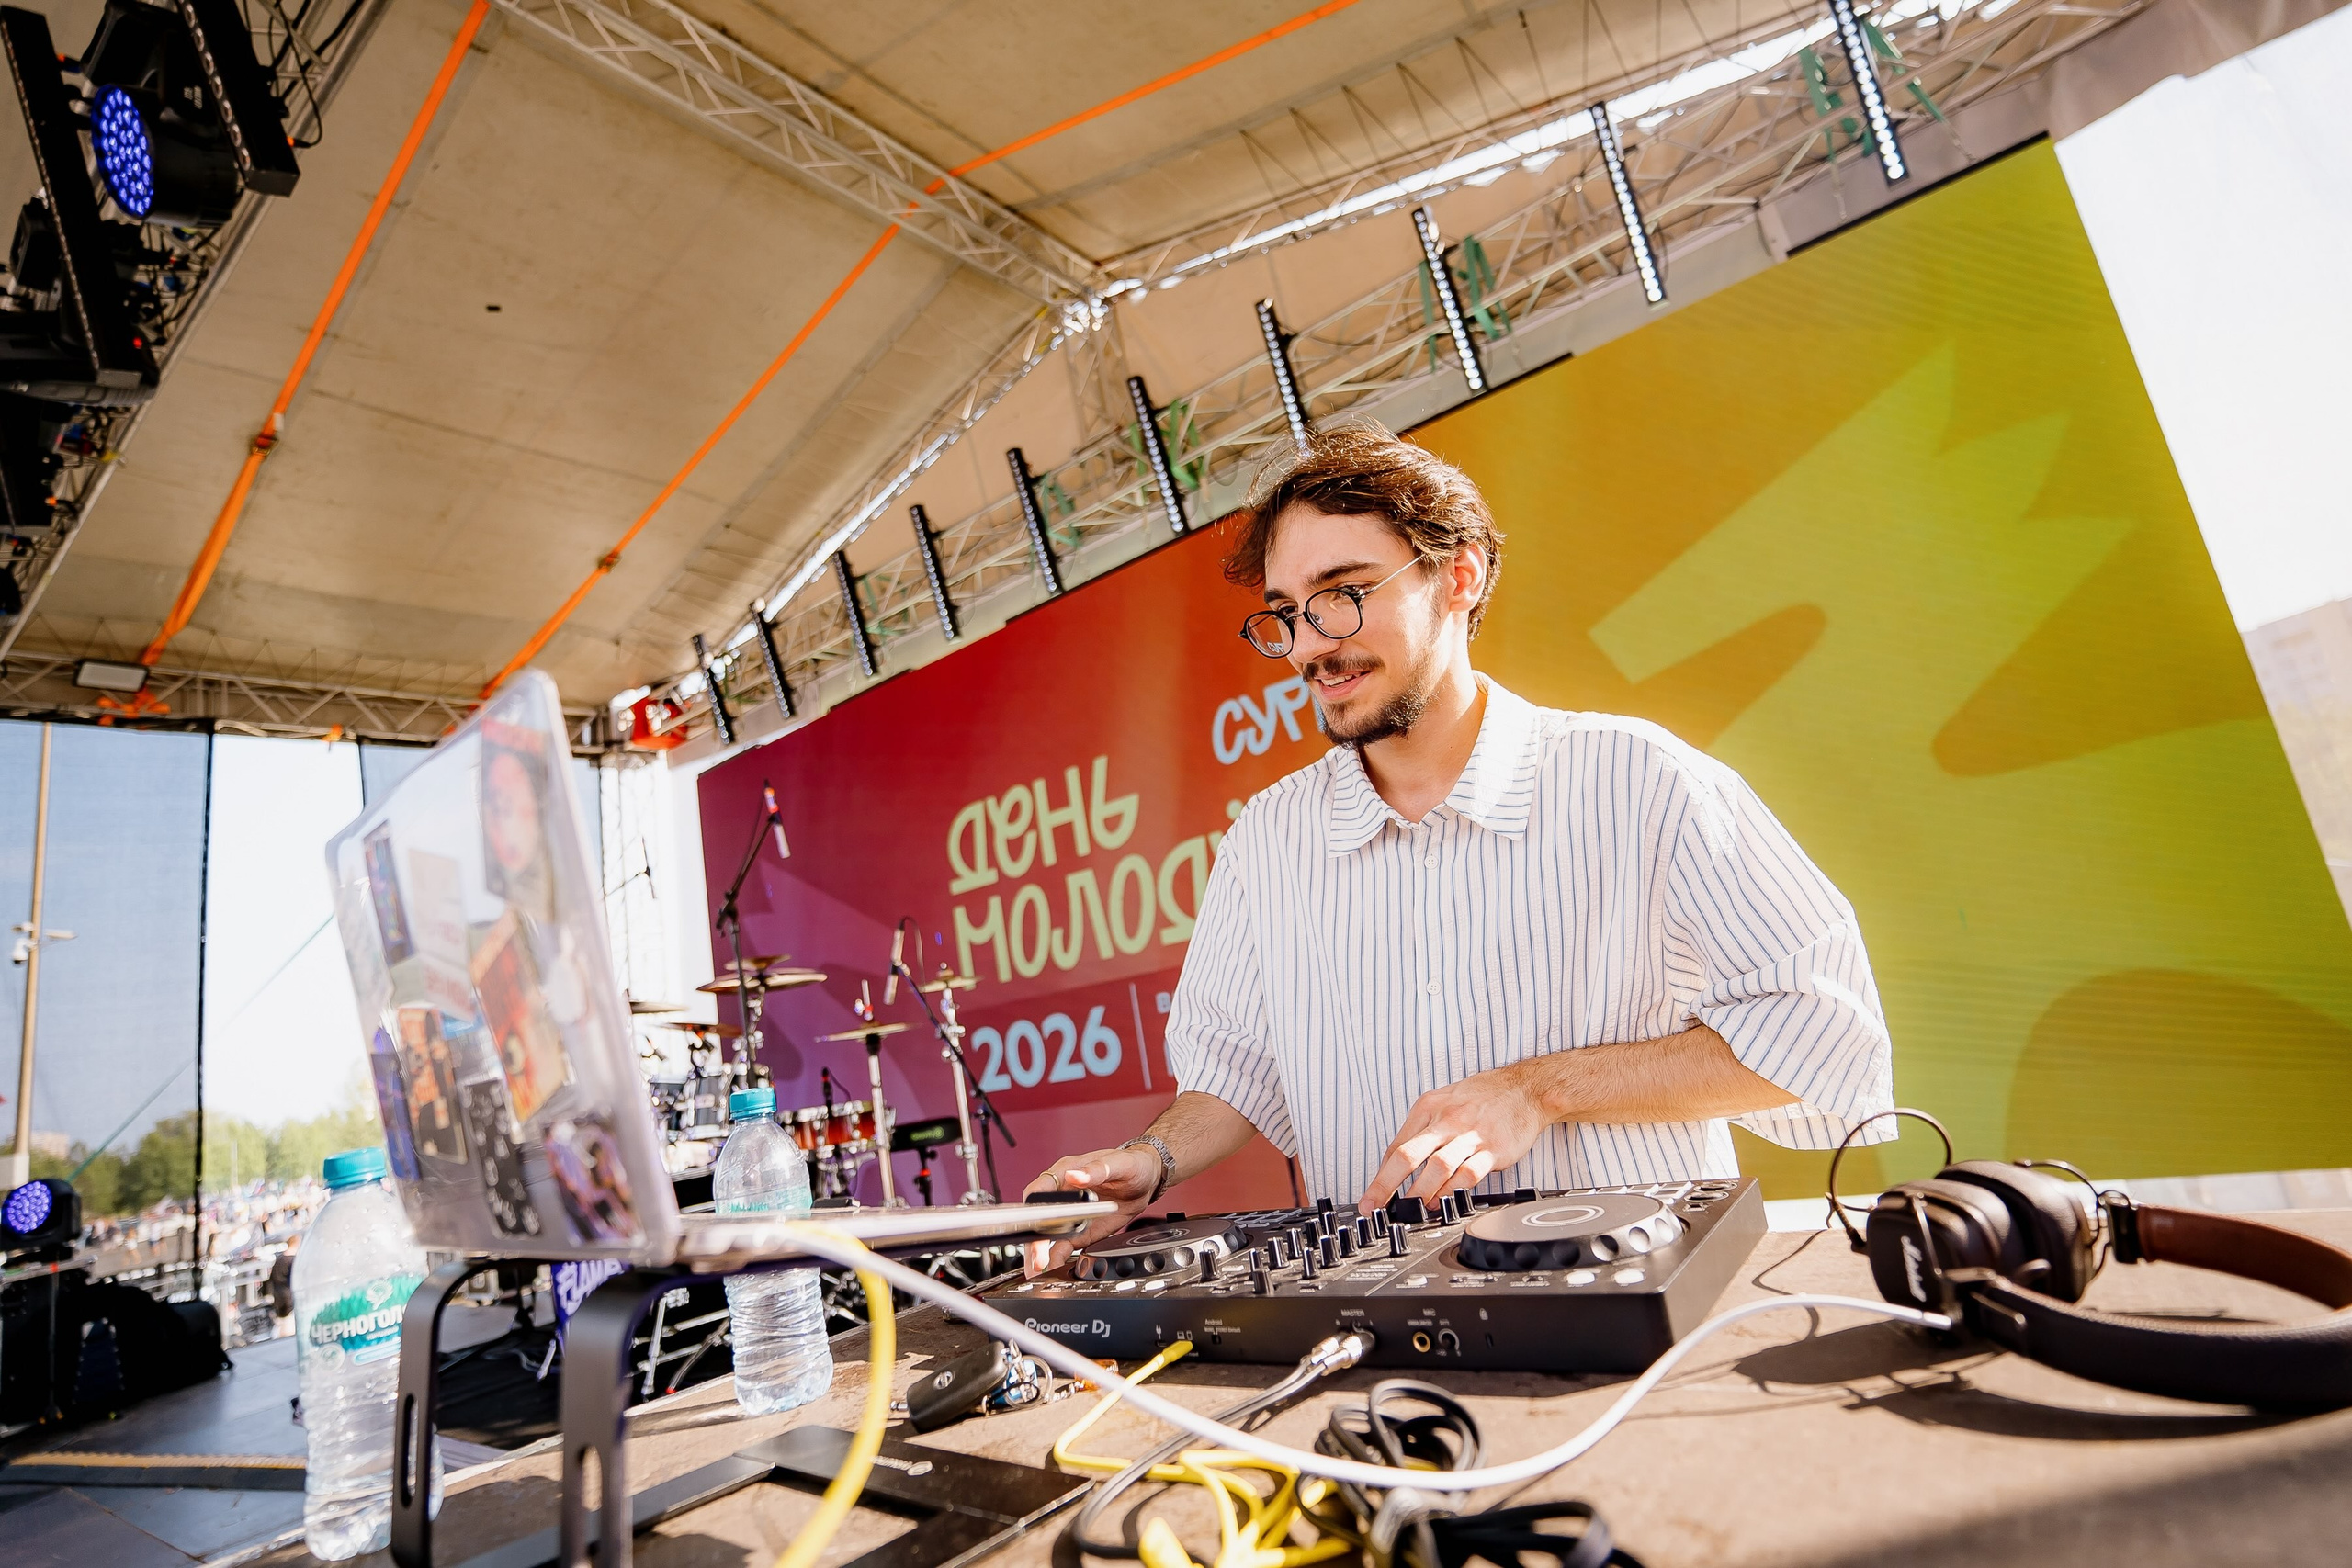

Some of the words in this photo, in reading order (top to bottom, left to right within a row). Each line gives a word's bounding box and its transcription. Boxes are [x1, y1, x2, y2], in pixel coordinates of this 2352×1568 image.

[1212, 674, 1326, 765] СУР
[952, 829, 1224, 990] МОЛОД
[972, 1006, 1122, 1093] 2026
[310, 1304, 407, 1345] ЧЕРНОГОЛ
[1024, 1317, 1089, 1334] Pioneer
